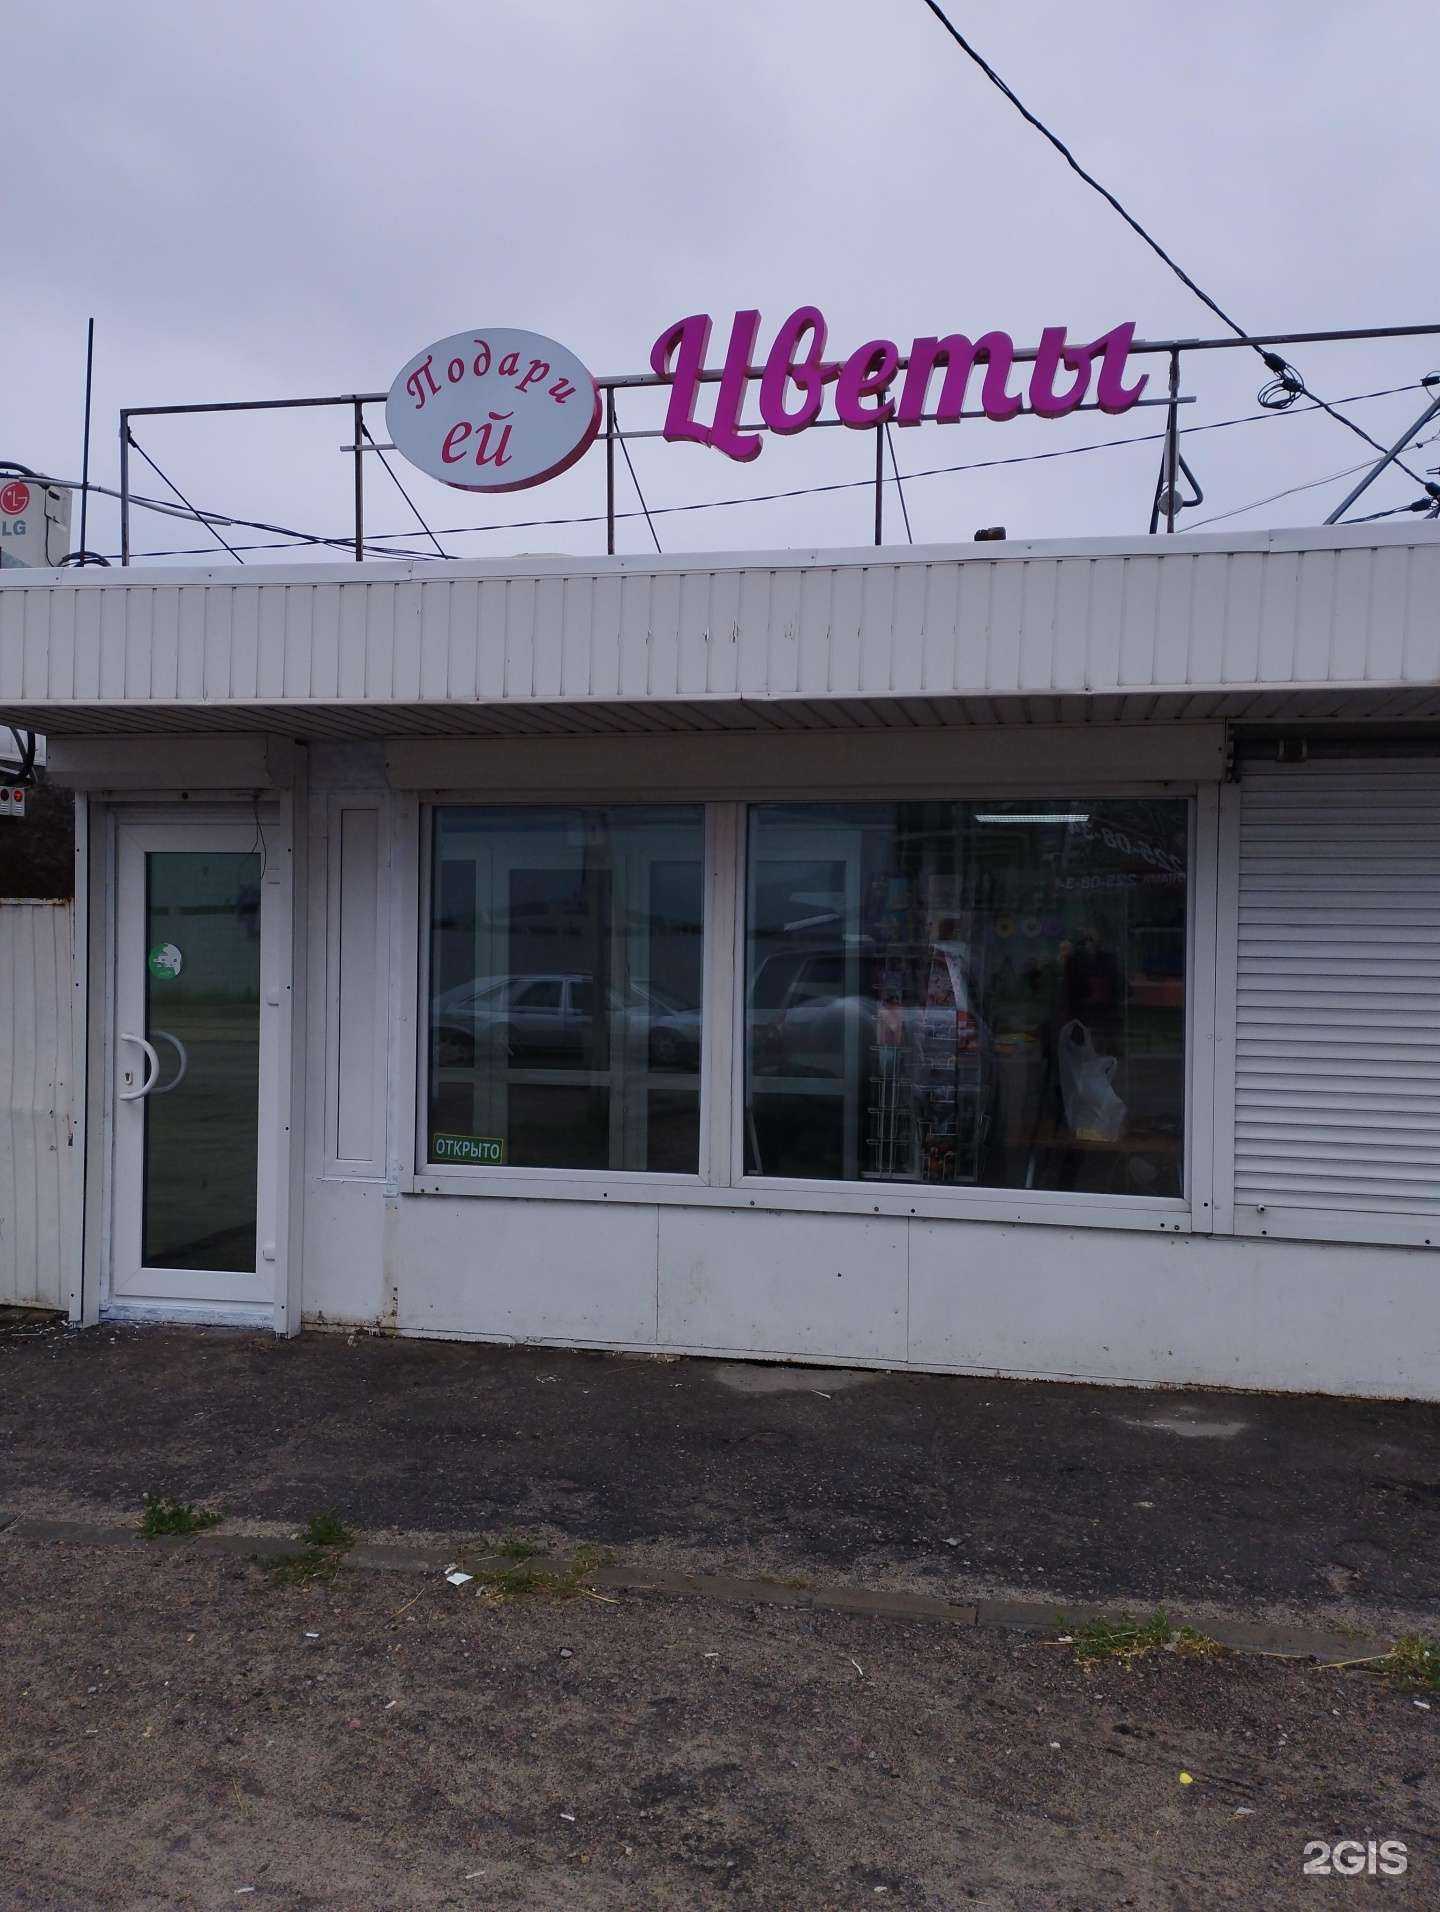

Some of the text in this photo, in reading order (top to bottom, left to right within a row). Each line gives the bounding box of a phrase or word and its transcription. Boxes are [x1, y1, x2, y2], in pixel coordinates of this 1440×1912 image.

[406, 339, 576, 410] Подари
[650, 305, 1150, 463] Цветы
[441, 410, 514, 467] ей
[1, 519, 26, 536] LG
[436, 1139, 500, 1159] ОТКРЫТО
